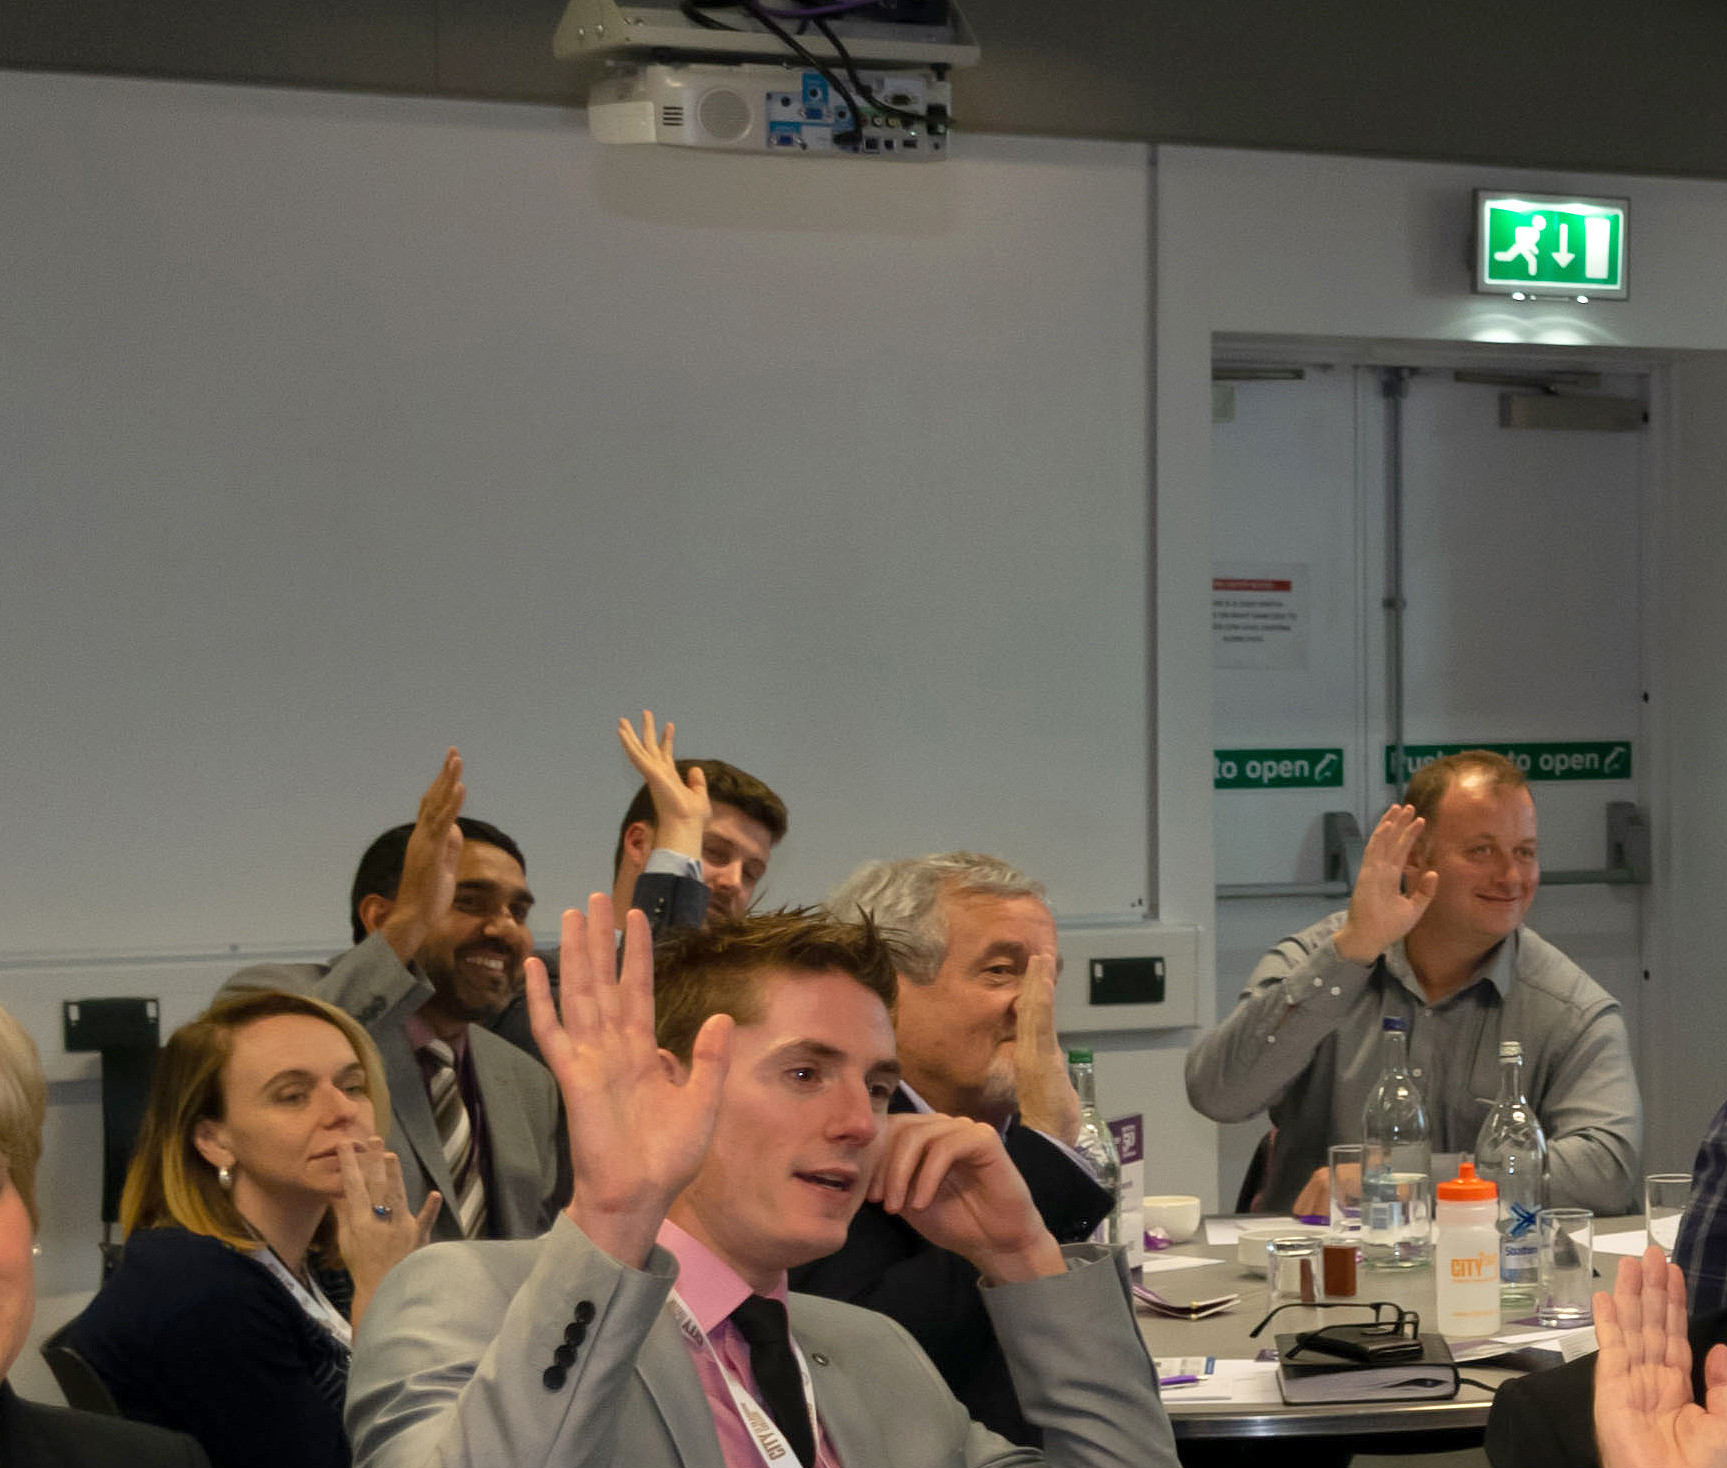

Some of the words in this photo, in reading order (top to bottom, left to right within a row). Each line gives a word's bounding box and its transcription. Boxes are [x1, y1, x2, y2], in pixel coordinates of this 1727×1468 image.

[1246, 758, 1309, 783] open
[1539, 750, 1599, 775] open
[1451, 1258, 1482, 1277] CITY
[757, 1432, 786, 1461] CITY
